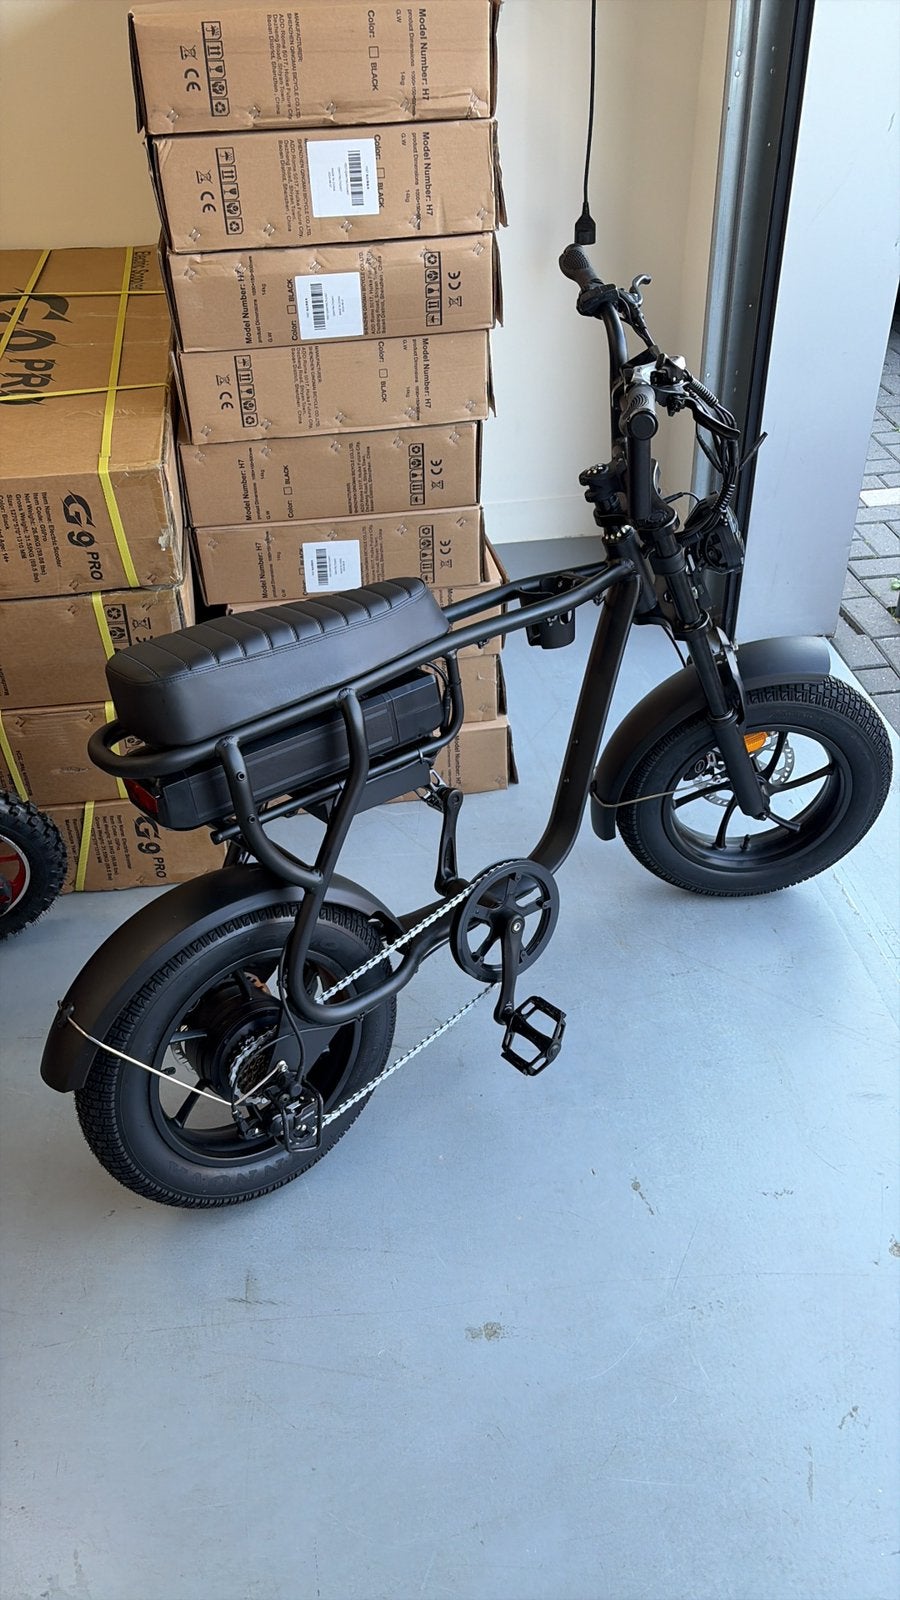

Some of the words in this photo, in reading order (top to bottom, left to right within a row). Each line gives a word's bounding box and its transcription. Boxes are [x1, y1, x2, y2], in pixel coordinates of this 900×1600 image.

[419, 9, 427, 39] Model
[371, 62, 379, 91] BLACK
[421, 43, 429, 85] Number:
[422, 88, 430, 101] H7
[424, 163, 432, 201] Number:
[426, 204, 433, 216] H7
[240, 284, 249, 318] Number:
[243, 320, 252, 344] Model
[422, 338, 430, 362] Model
[423, 364, 431, 396] Number:
[425, 398, 431, 408] H7
[238, 459, 245, 469] H7
[241, 470, 249, 499] Number:
[243, 501, 252, 521] Model
[49, 525, 57, 546] Electric
[60, 490, 98, 547] G9
[86, 552, 104, 580] PRO
[255, 542, 262, 551] H7
[257, 552, 265, 579] Number:
[260, 580, 268, 598] Model
[133, 813, 163, 854] G9
[153, 857, 167, 879] PRO
